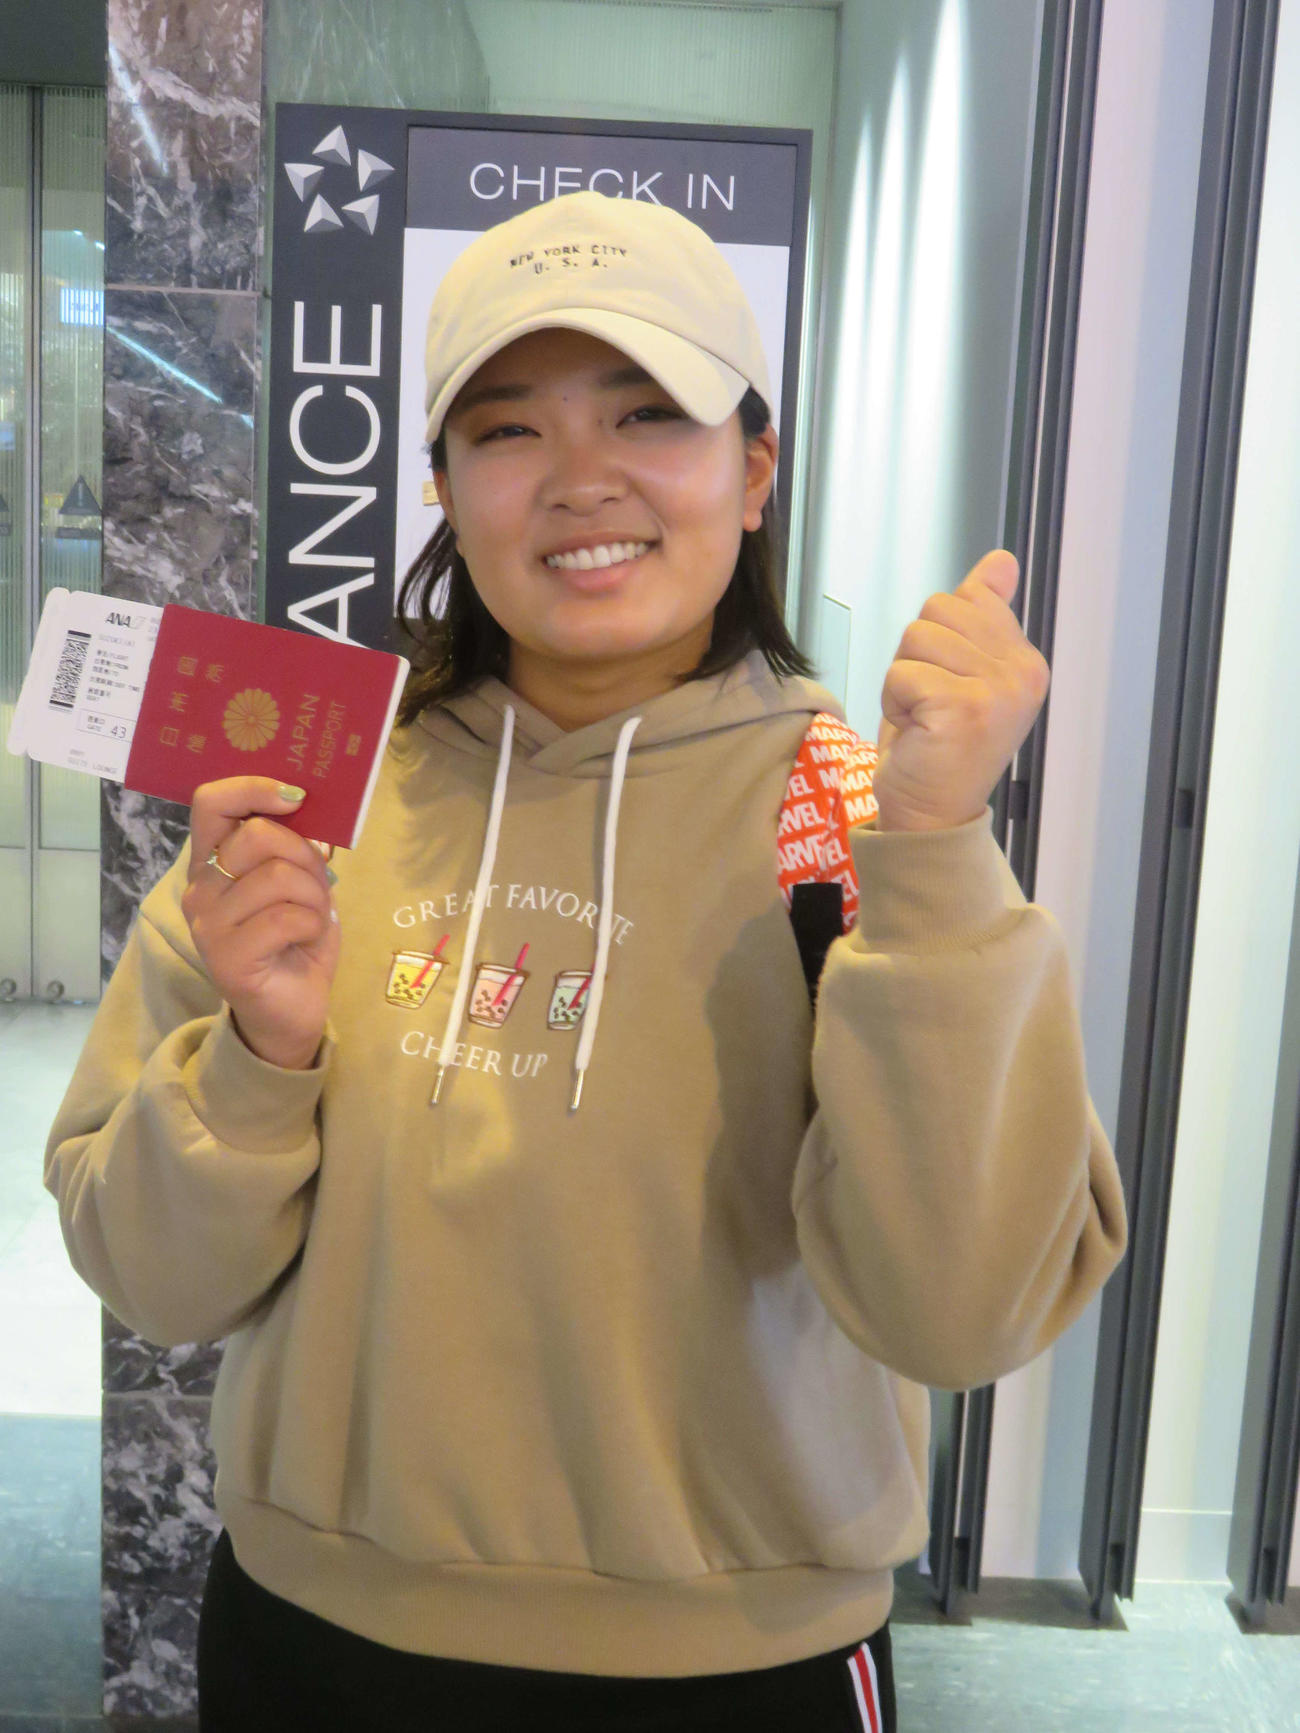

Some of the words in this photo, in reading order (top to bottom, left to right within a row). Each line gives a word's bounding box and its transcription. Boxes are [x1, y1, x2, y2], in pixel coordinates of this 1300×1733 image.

[686, 173, 736, 211] IN
[543, 245, 581, 257] YORK
[591, 244, 628, 257] CITY
[106, 611, 131, 629] ANA
[110, 725, 127, 739] 43
[287, 693, 321, 772] JAPAN
[312, 700, 346, 779] PASSPORT
[511, 1053, 548, 1078] UP
